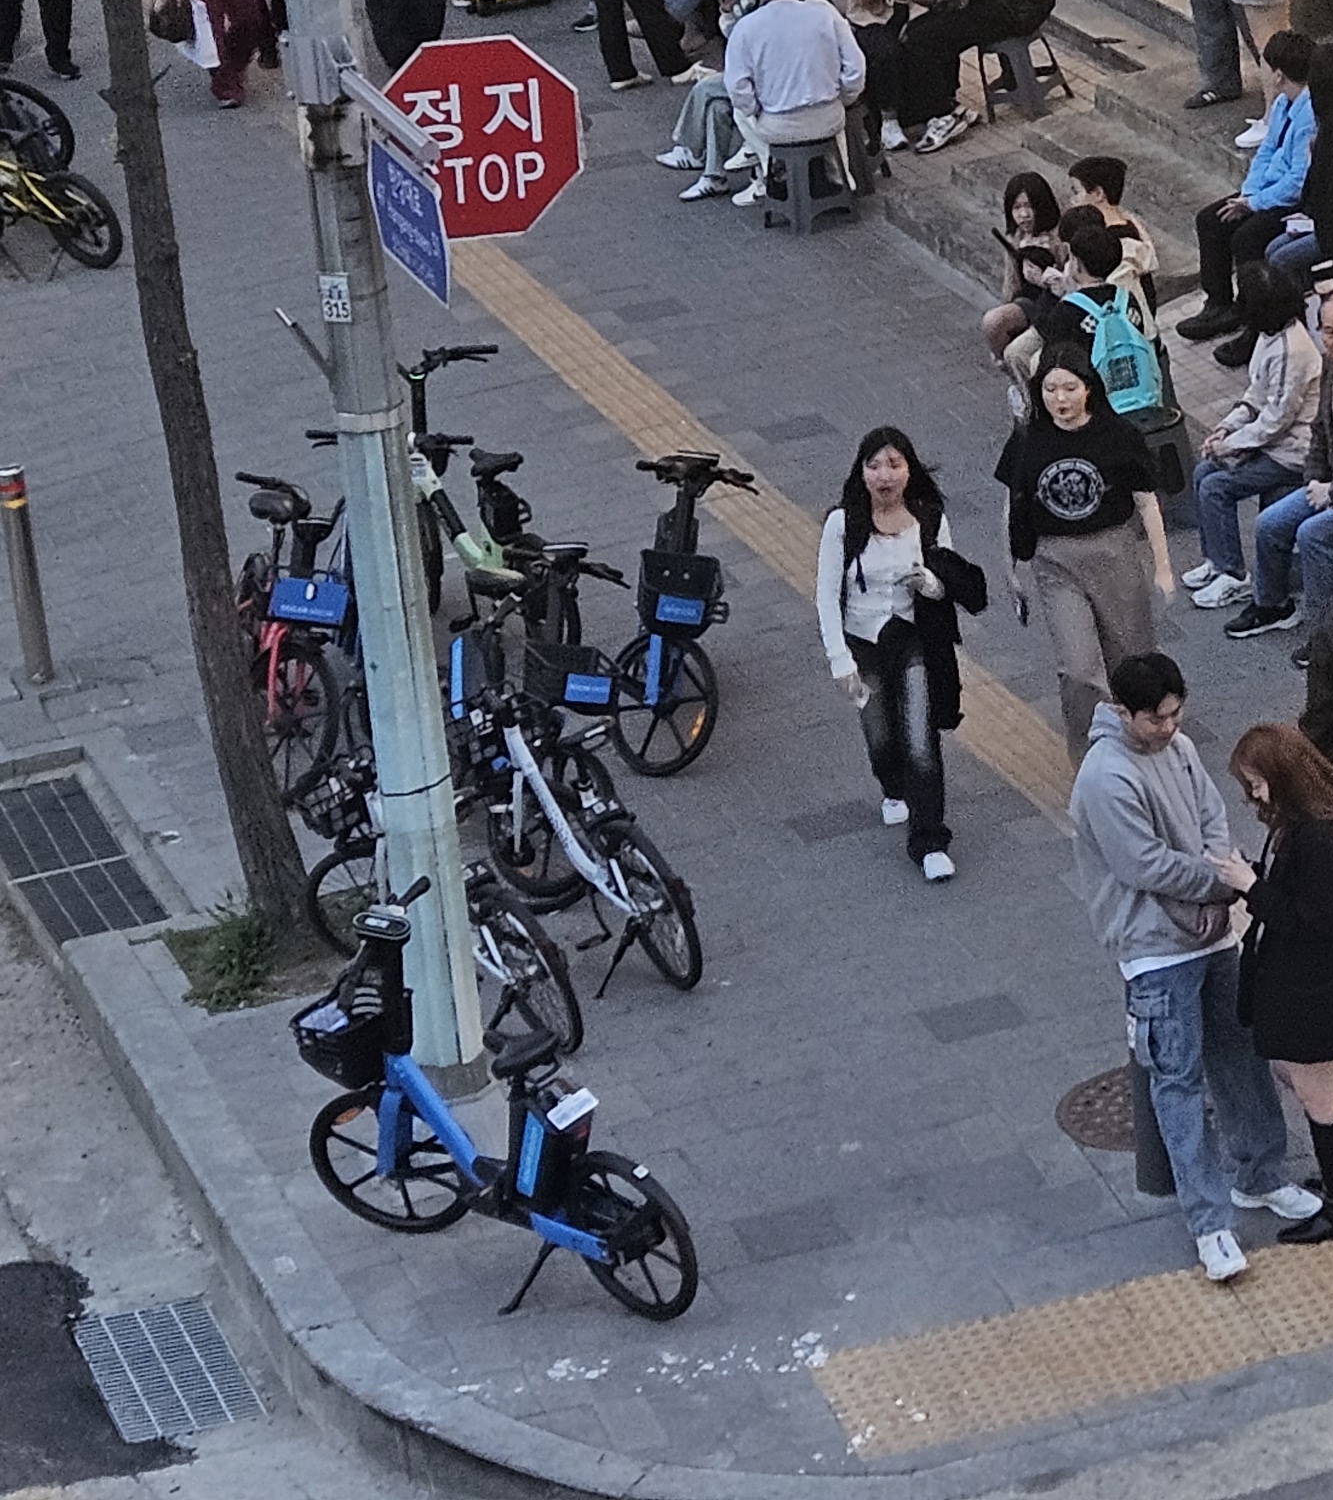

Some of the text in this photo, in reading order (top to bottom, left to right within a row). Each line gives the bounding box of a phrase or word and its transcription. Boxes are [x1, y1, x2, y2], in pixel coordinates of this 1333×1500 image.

[403, 76, 543, 151] 정지
[424, 150, 546, 205] TOP
[324, 299, 350, 319] 315
